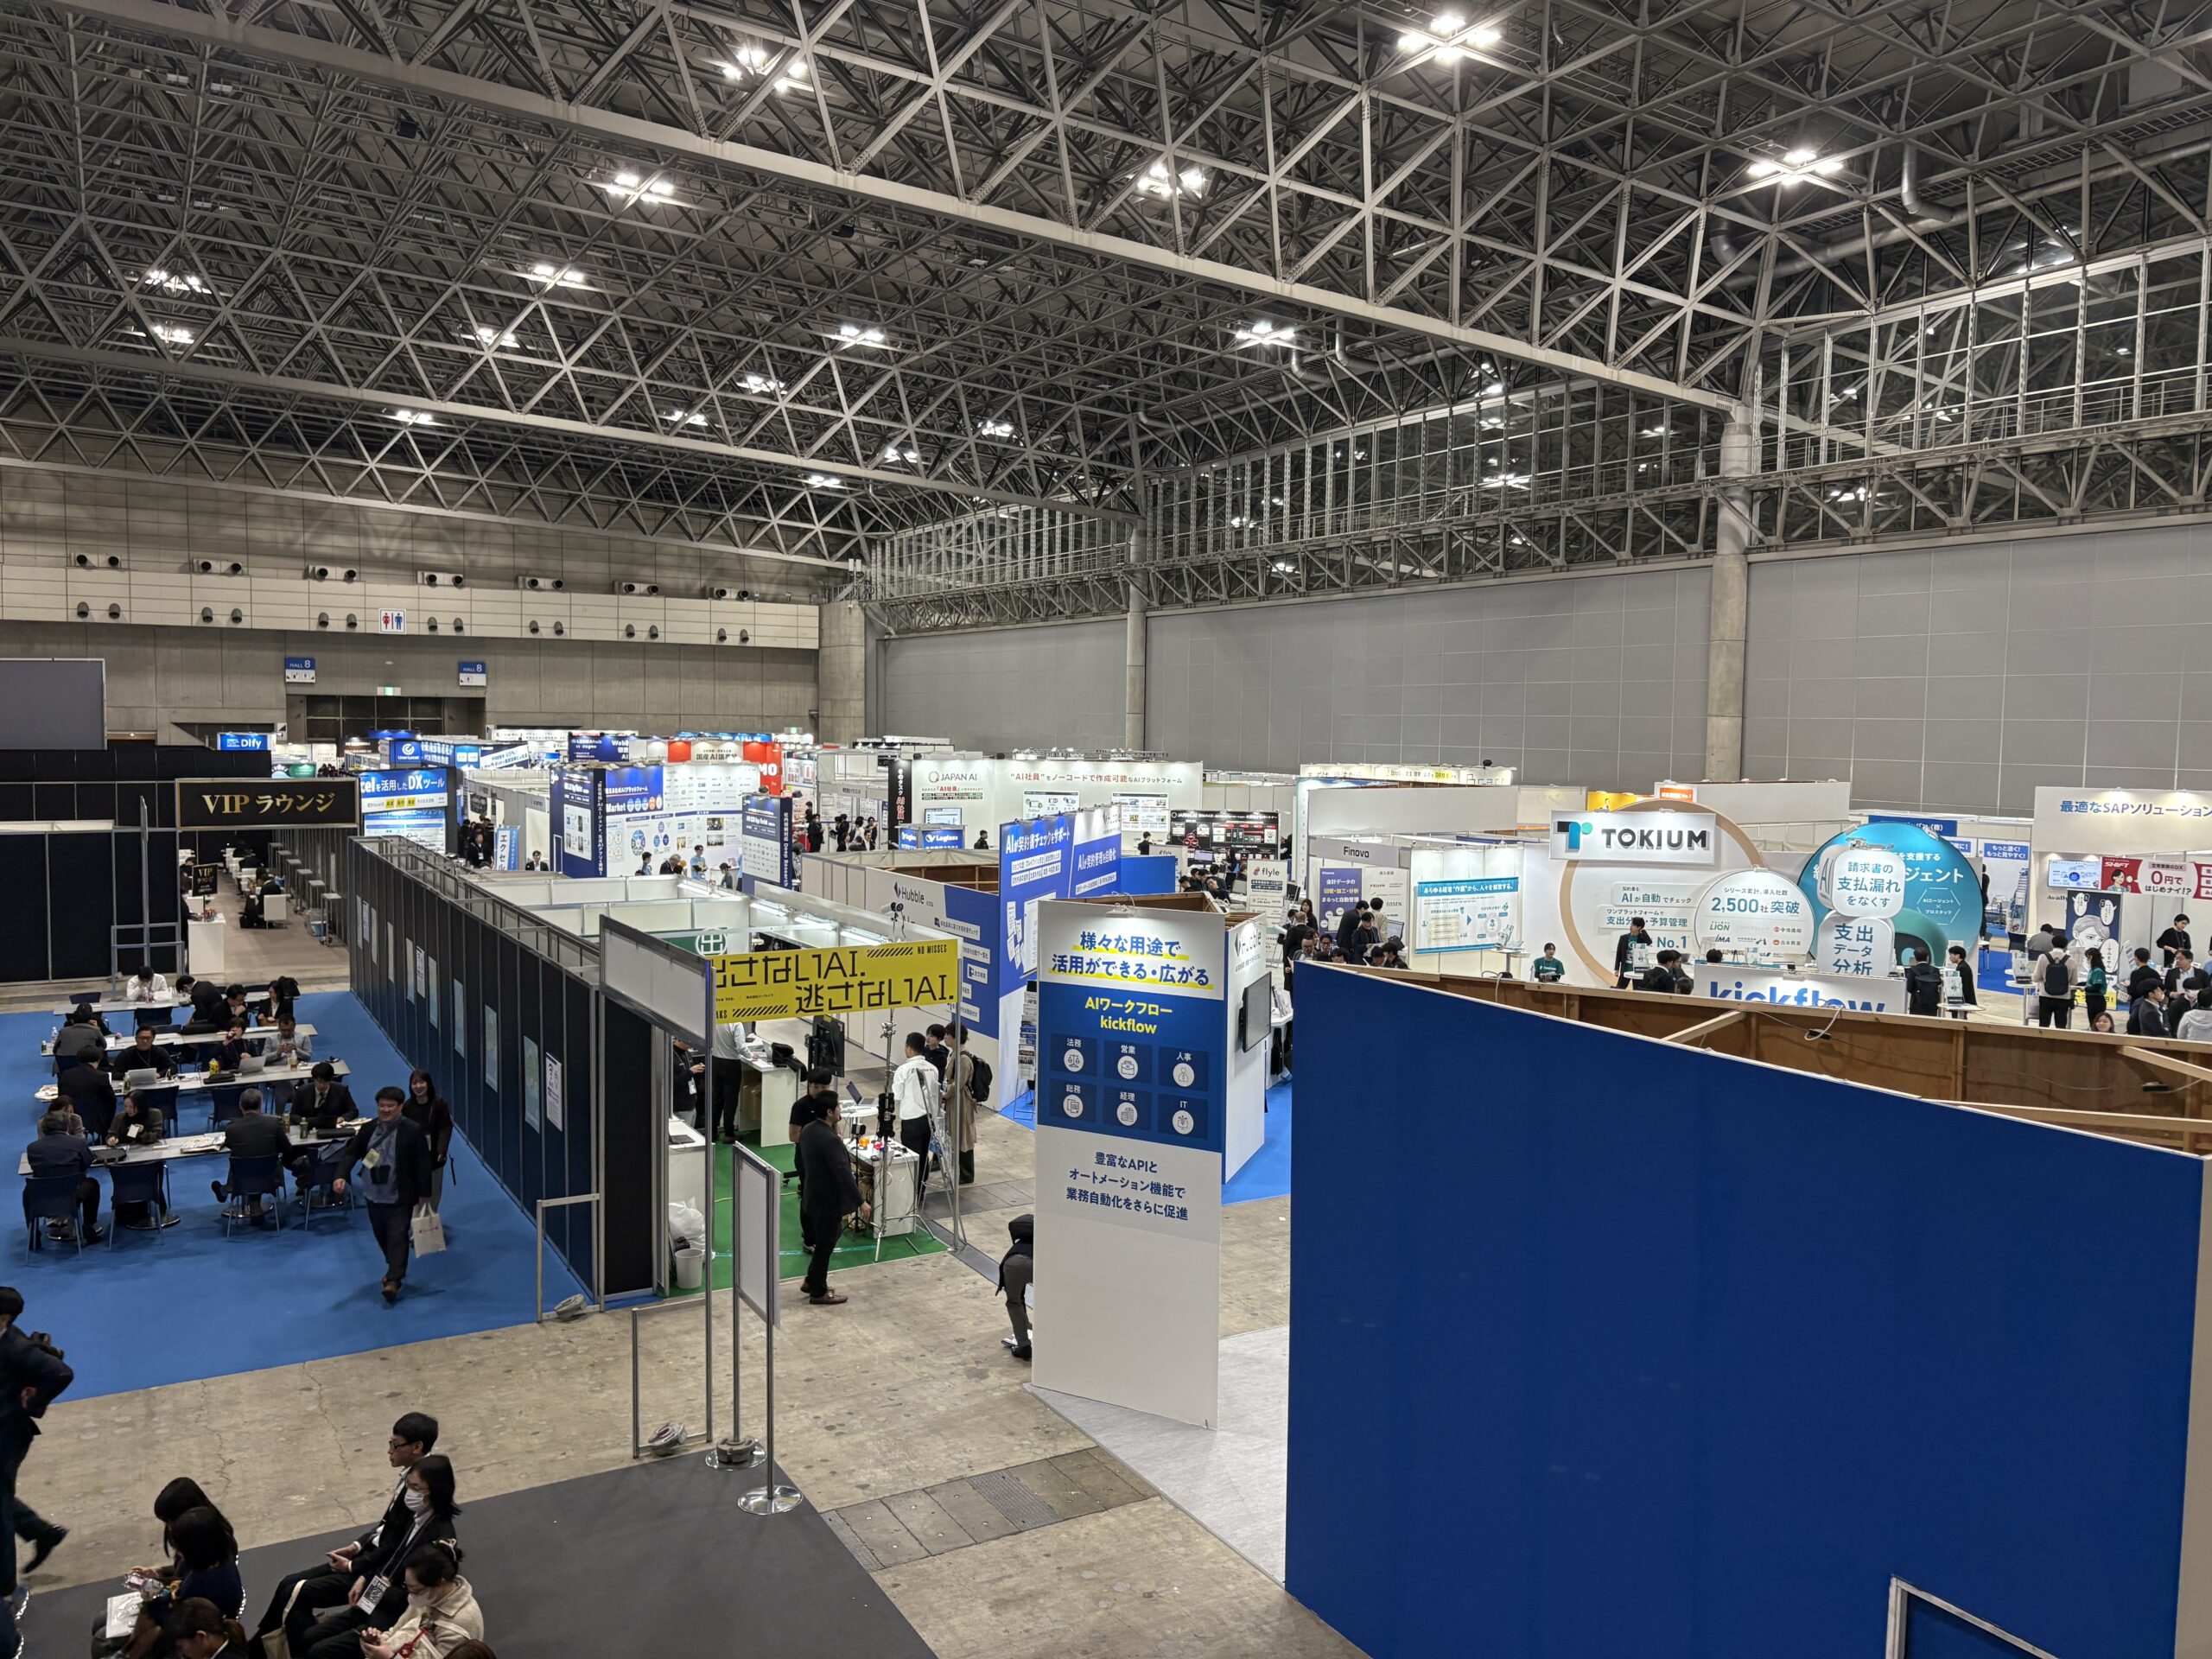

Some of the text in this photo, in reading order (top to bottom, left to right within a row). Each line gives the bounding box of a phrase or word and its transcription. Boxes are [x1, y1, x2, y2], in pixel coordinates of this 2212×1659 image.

[304, 659, 311, 668] 8
[476, 664, 482, 672] 8
[201, 791, 335, 815] VIP ラウンジ
[2060, 800, 2212, 817] 最適なSAPソリューション
[1601, 828, 1710, 851] TOKIUM
[1262, 868, 1280, 878] flyle
[1847, 861, 1893, 874] 請求書の
[1837, 876, 1901, 893] 支払漏れ
[2151, 870, 2183, 886] 0円で
[902, 886, 925, 905] Hubble
[2145, 885, 2192, 895] はじめナイ!?
[1621, 893, 1692, 904] AIが自動でチェック
[1711, 897, 1800, 914] 2,500社突破
[1847, 897, 1891, 907] をなくす
[1606, 916, 1688, 927] 支出分・予算管理
[1834, 924, 1873, 944] 支出
[917, 944, 947, 955] NO MISSES
[1079, 931, 1182, 957] 様々な用途で
[1656, 936, 1688, 949] No.1
[1833, 944, 1872, 957] データ
[1052, 953, 1211, 987] 活用ができる・広がる
[1832, 959, 1873, 976] 分析
[796, 974, 954, 1014] 逃さないAI.
[1084, 995, 1173, 1017] AIワークフロー
[1100, 1015, 1158, 1035] kickflow
[1066, 1038, 1083, 1048] 法務
[1120, 1044, 1136, 1055] 営業
[1176, 1051, 1192, 1062] 人事
[1065, 1084, 1082, 1094] 総務
[1119, 1090, 1135, 1102] 経理
[1179, 1100, 1188, 1109] IT
[1094, 1151, 1158, 1174] 豊富なAPIと
[1068, 1167, 1186, 1199] オートメーション機能で
[1065, 1186, 1189, 1221] 業務自動化をさらに促進
